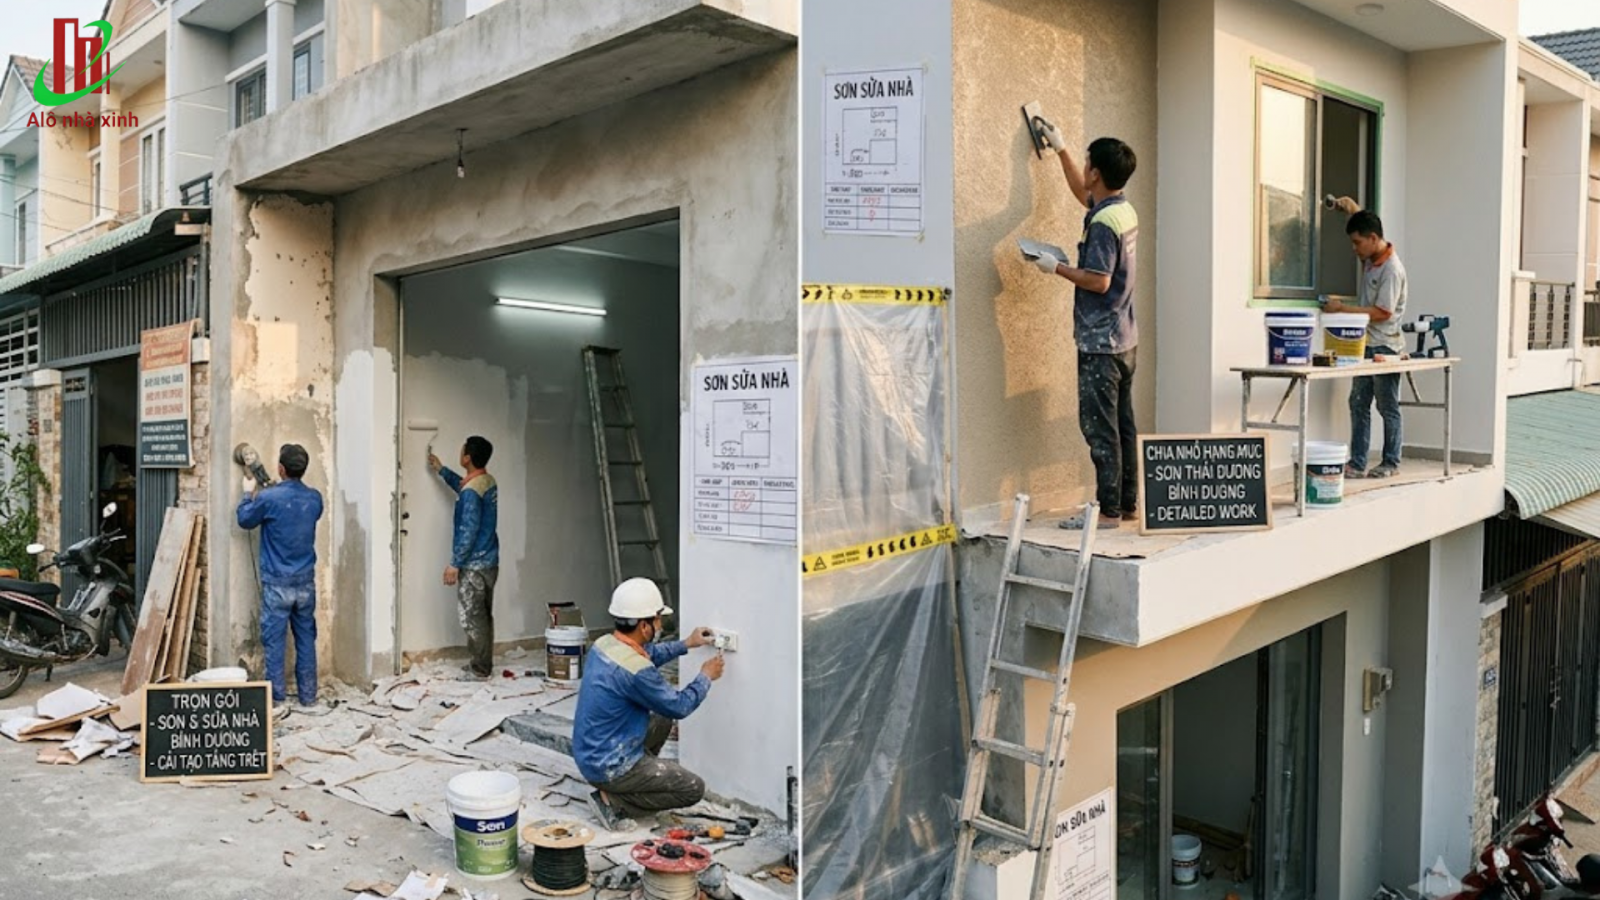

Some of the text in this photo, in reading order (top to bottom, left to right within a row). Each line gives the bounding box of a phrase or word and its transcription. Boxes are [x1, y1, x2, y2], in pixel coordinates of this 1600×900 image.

[888, 76, 914, 97] NHÀ
[1146, 445, 1175, 460] CHIA
[1157, 505, 1216, 521] DETAILED
[1219, 504, 1257, 519] WORK
[180, 754, 203, 773] TẠO
